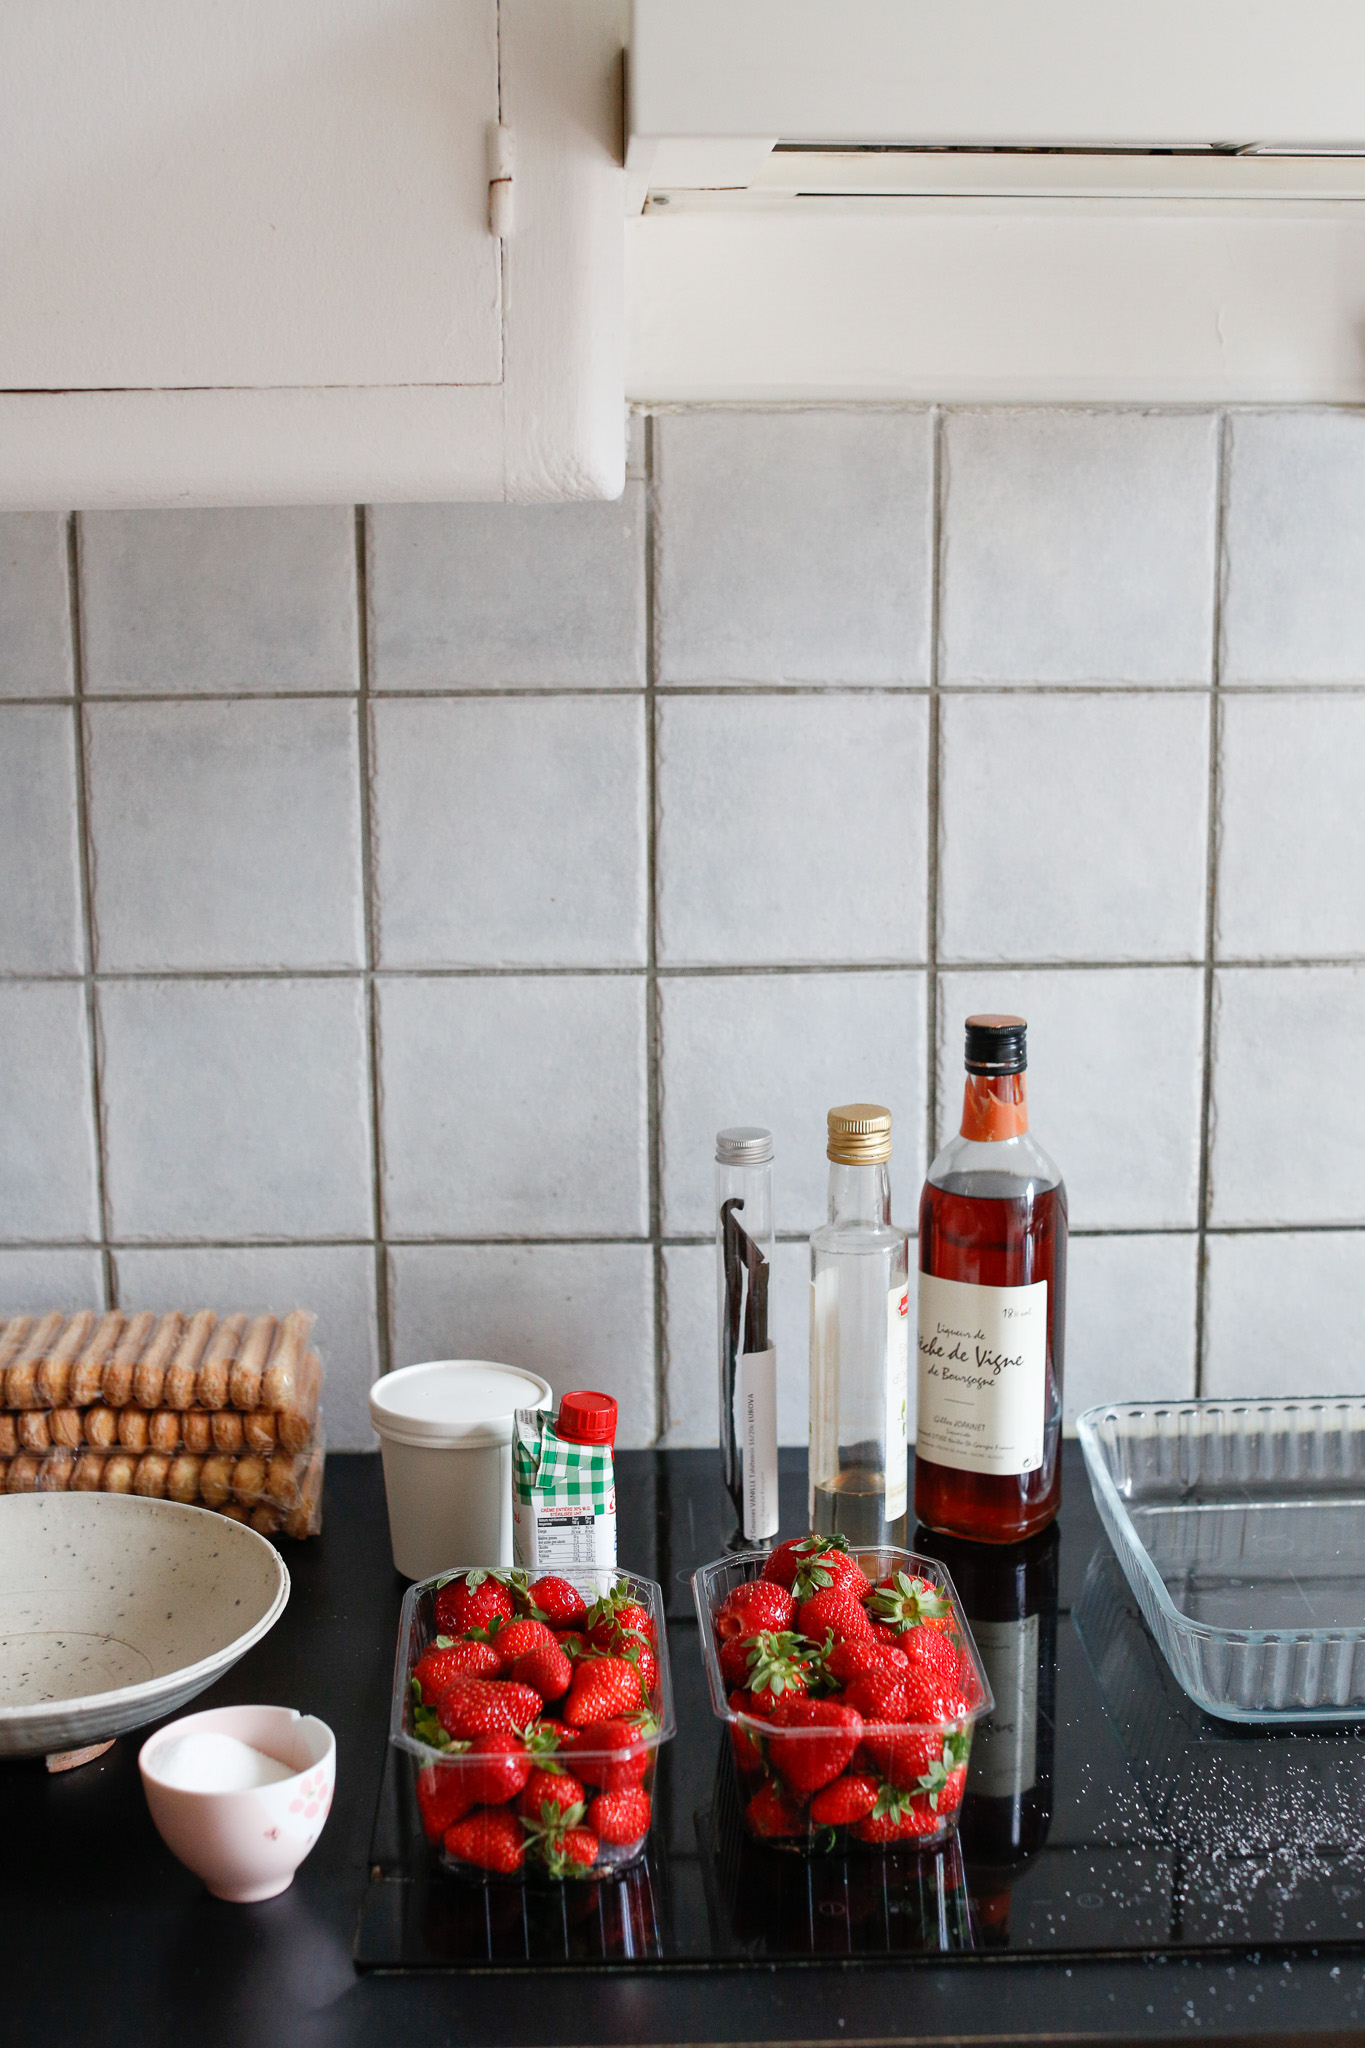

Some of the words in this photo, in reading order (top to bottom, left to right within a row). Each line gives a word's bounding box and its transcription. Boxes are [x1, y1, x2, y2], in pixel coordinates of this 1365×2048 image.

[937, 1322, 971, 1338] Liqueur
[974, 1329, 985, 1340] de
[918, 1336, 945, 1357] êche
[948, 1342, 970, 1362] de
[976, 1346, 1024, 1375] Vigne
[928, 1364, 939, 1376] de
[942, 1367, 996, 1389] Bourgogne
